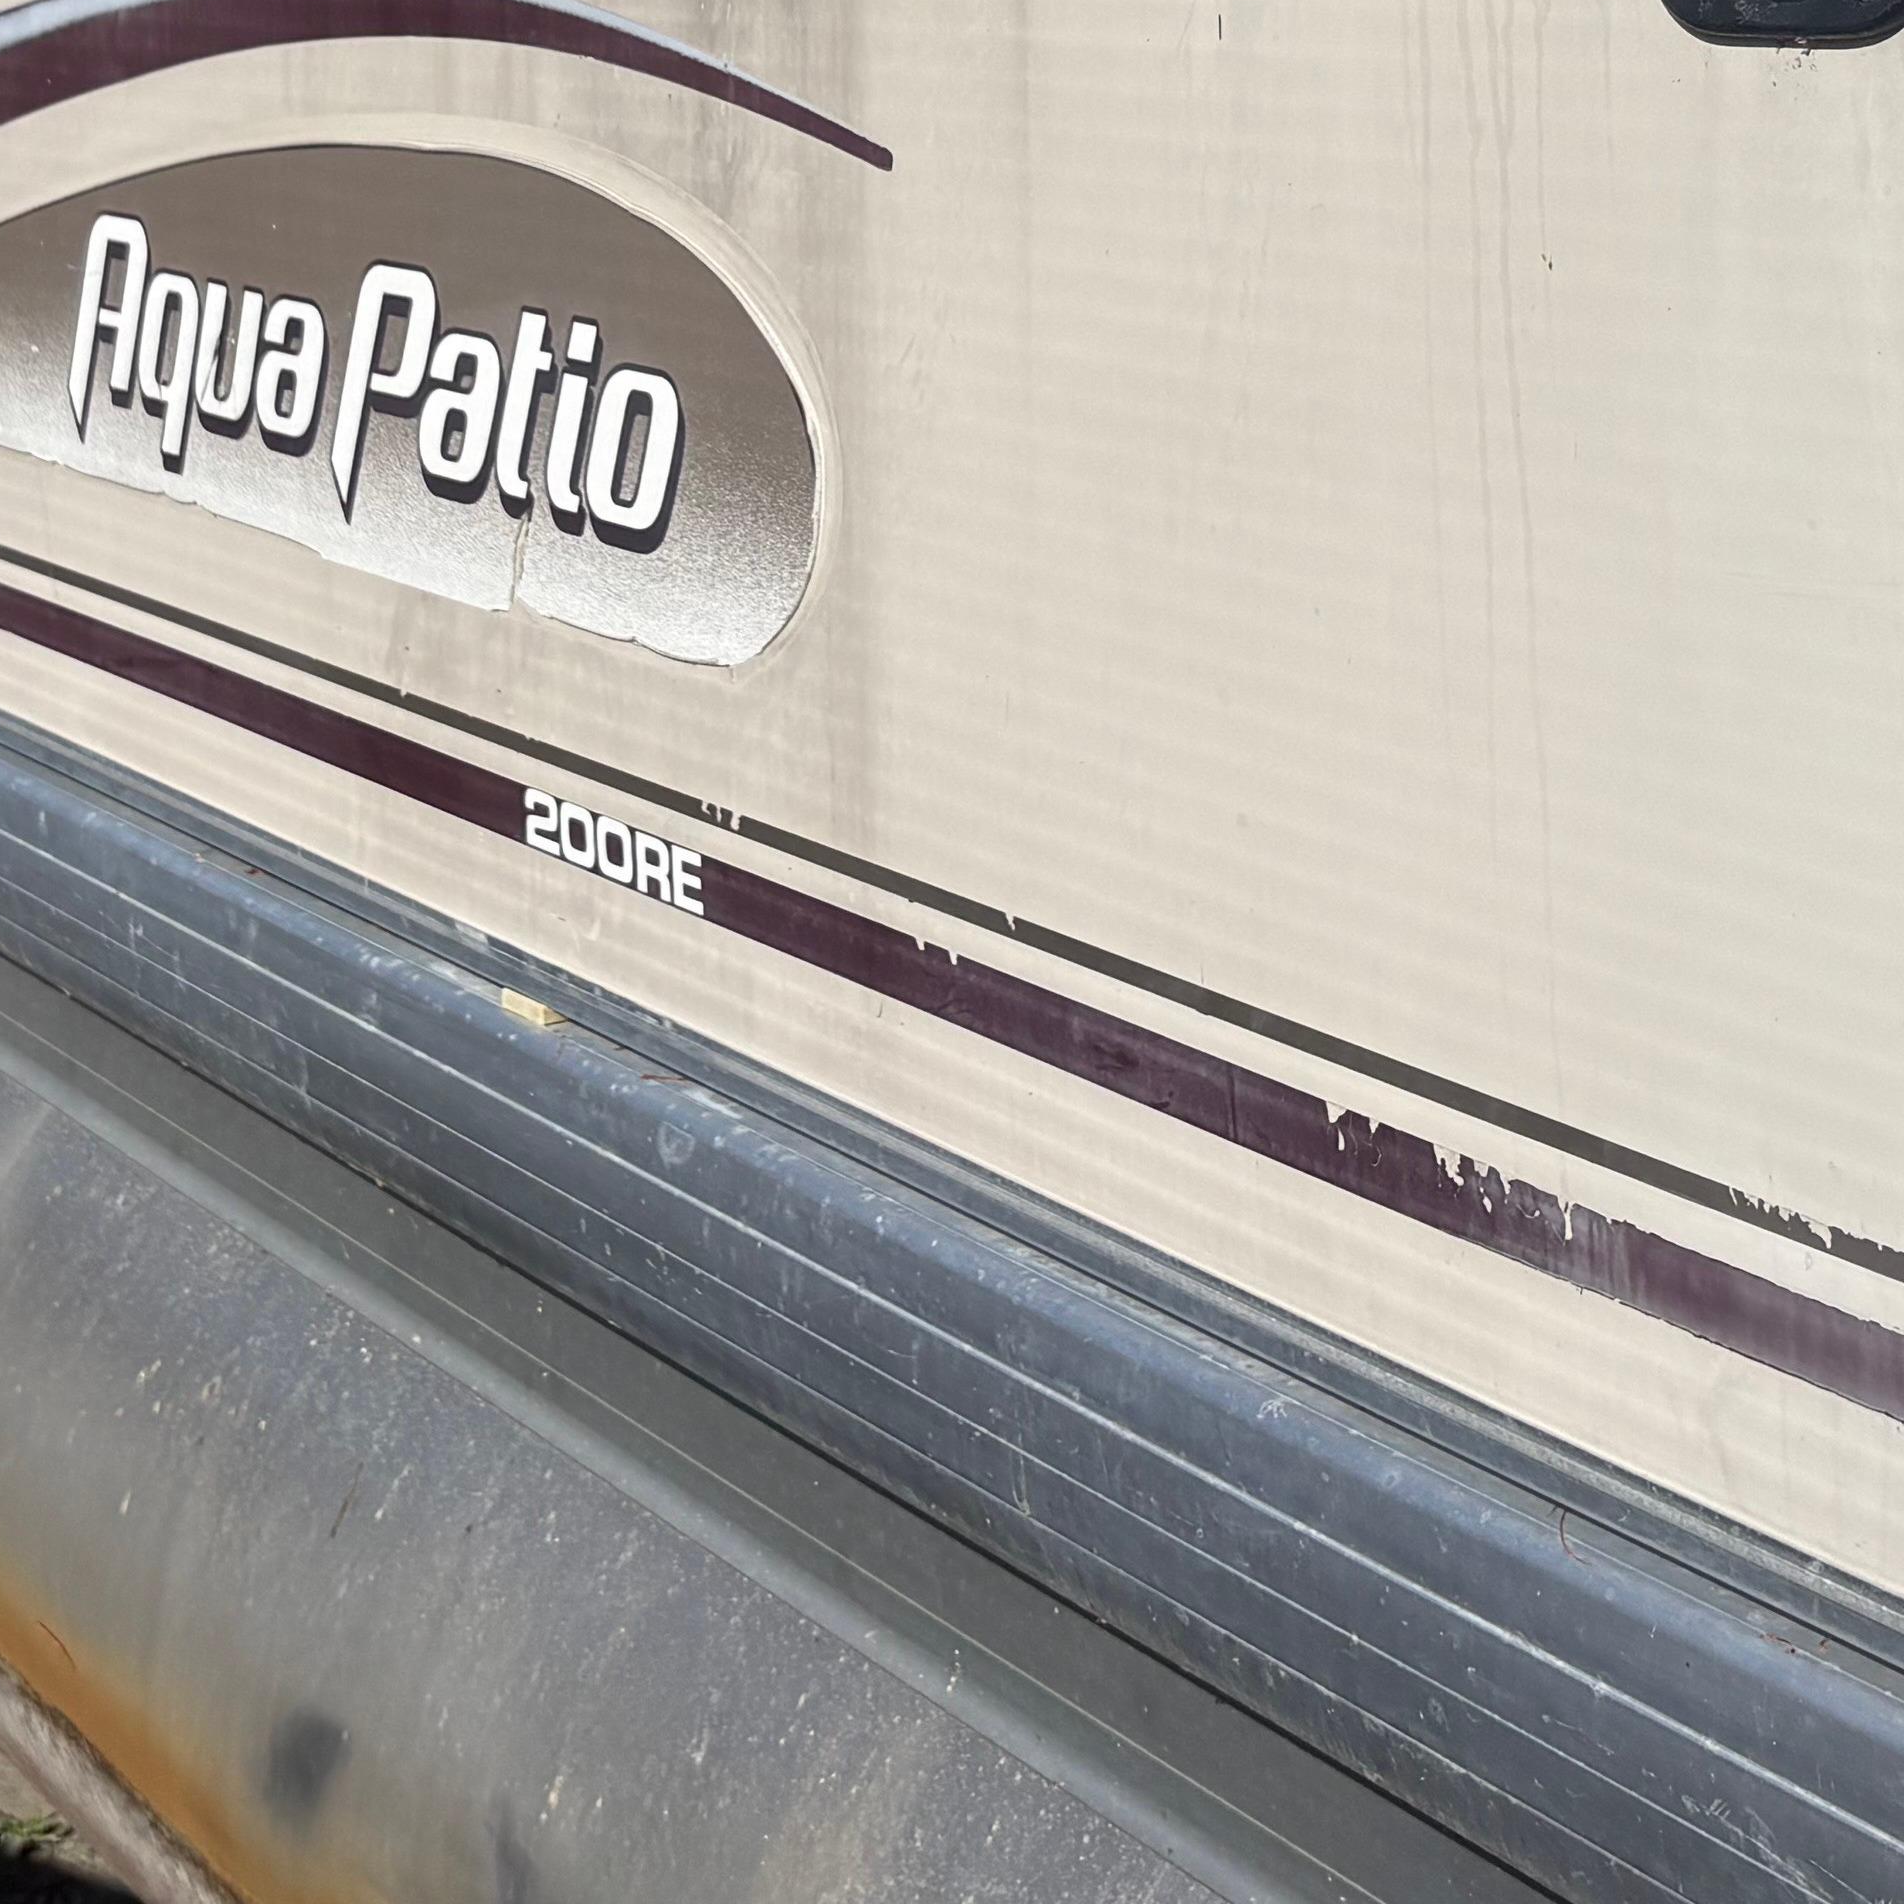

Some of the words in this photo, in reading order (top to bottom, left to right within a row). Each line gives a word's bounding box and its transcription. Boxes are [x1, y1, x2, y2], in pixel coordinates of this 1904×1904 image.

[67, 210, 326, 474] Aqua
[330, 260, 687, 554] Patio
[524, 787, 704, 916] 200RE
